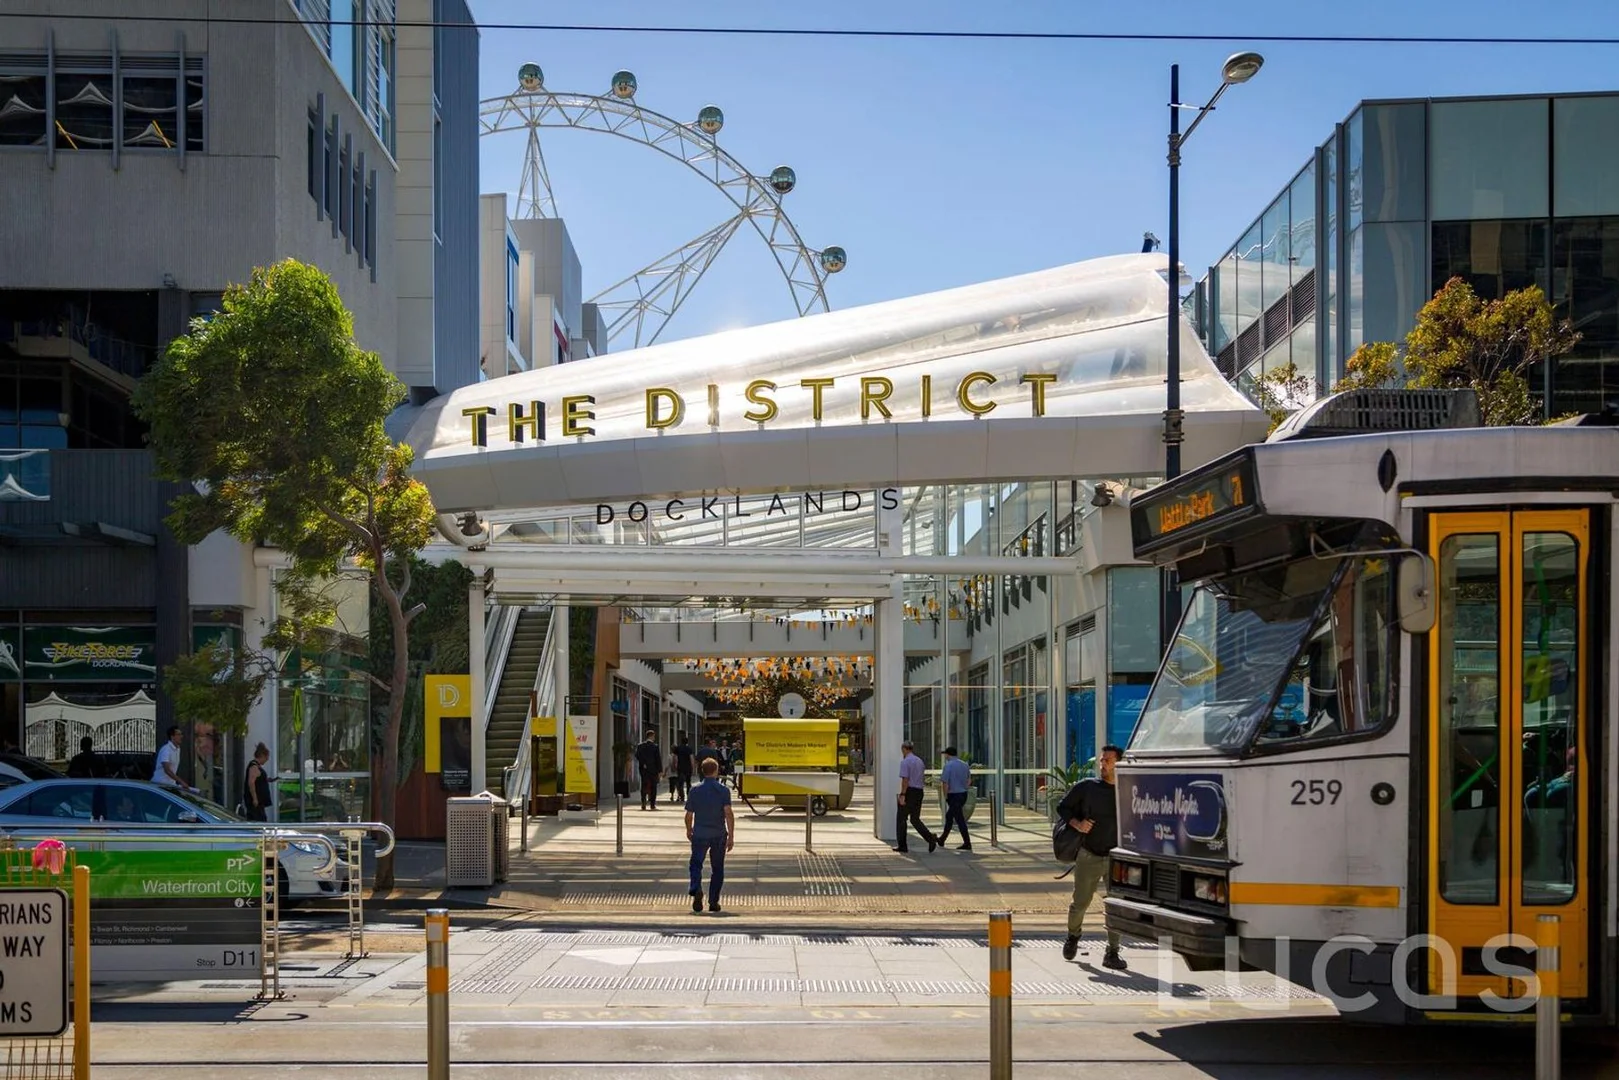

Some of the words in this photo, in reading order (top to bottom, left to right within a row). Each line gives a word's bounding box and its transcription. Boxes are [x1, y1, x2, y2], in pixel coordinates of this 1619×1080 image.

[461, 394, 596, 447] THE
[645, 371, 1058, 429] DISTRICT
[596, 488, 900, 526] DOCKLANDS
[1131, 785, 1160, 820] Explore
[1160, 795, 1174, 815] the
[1290, 779, 1343, 806] 259
[142, 878, 222, 894] Waterfront
[225, 879, 256, 897] City
[0, 903, 52, 925] RIANS
[3, 936, 45, 958] WAY
[196, 957, 216, 968] Stop
[223, 950, 257, 967] D11
